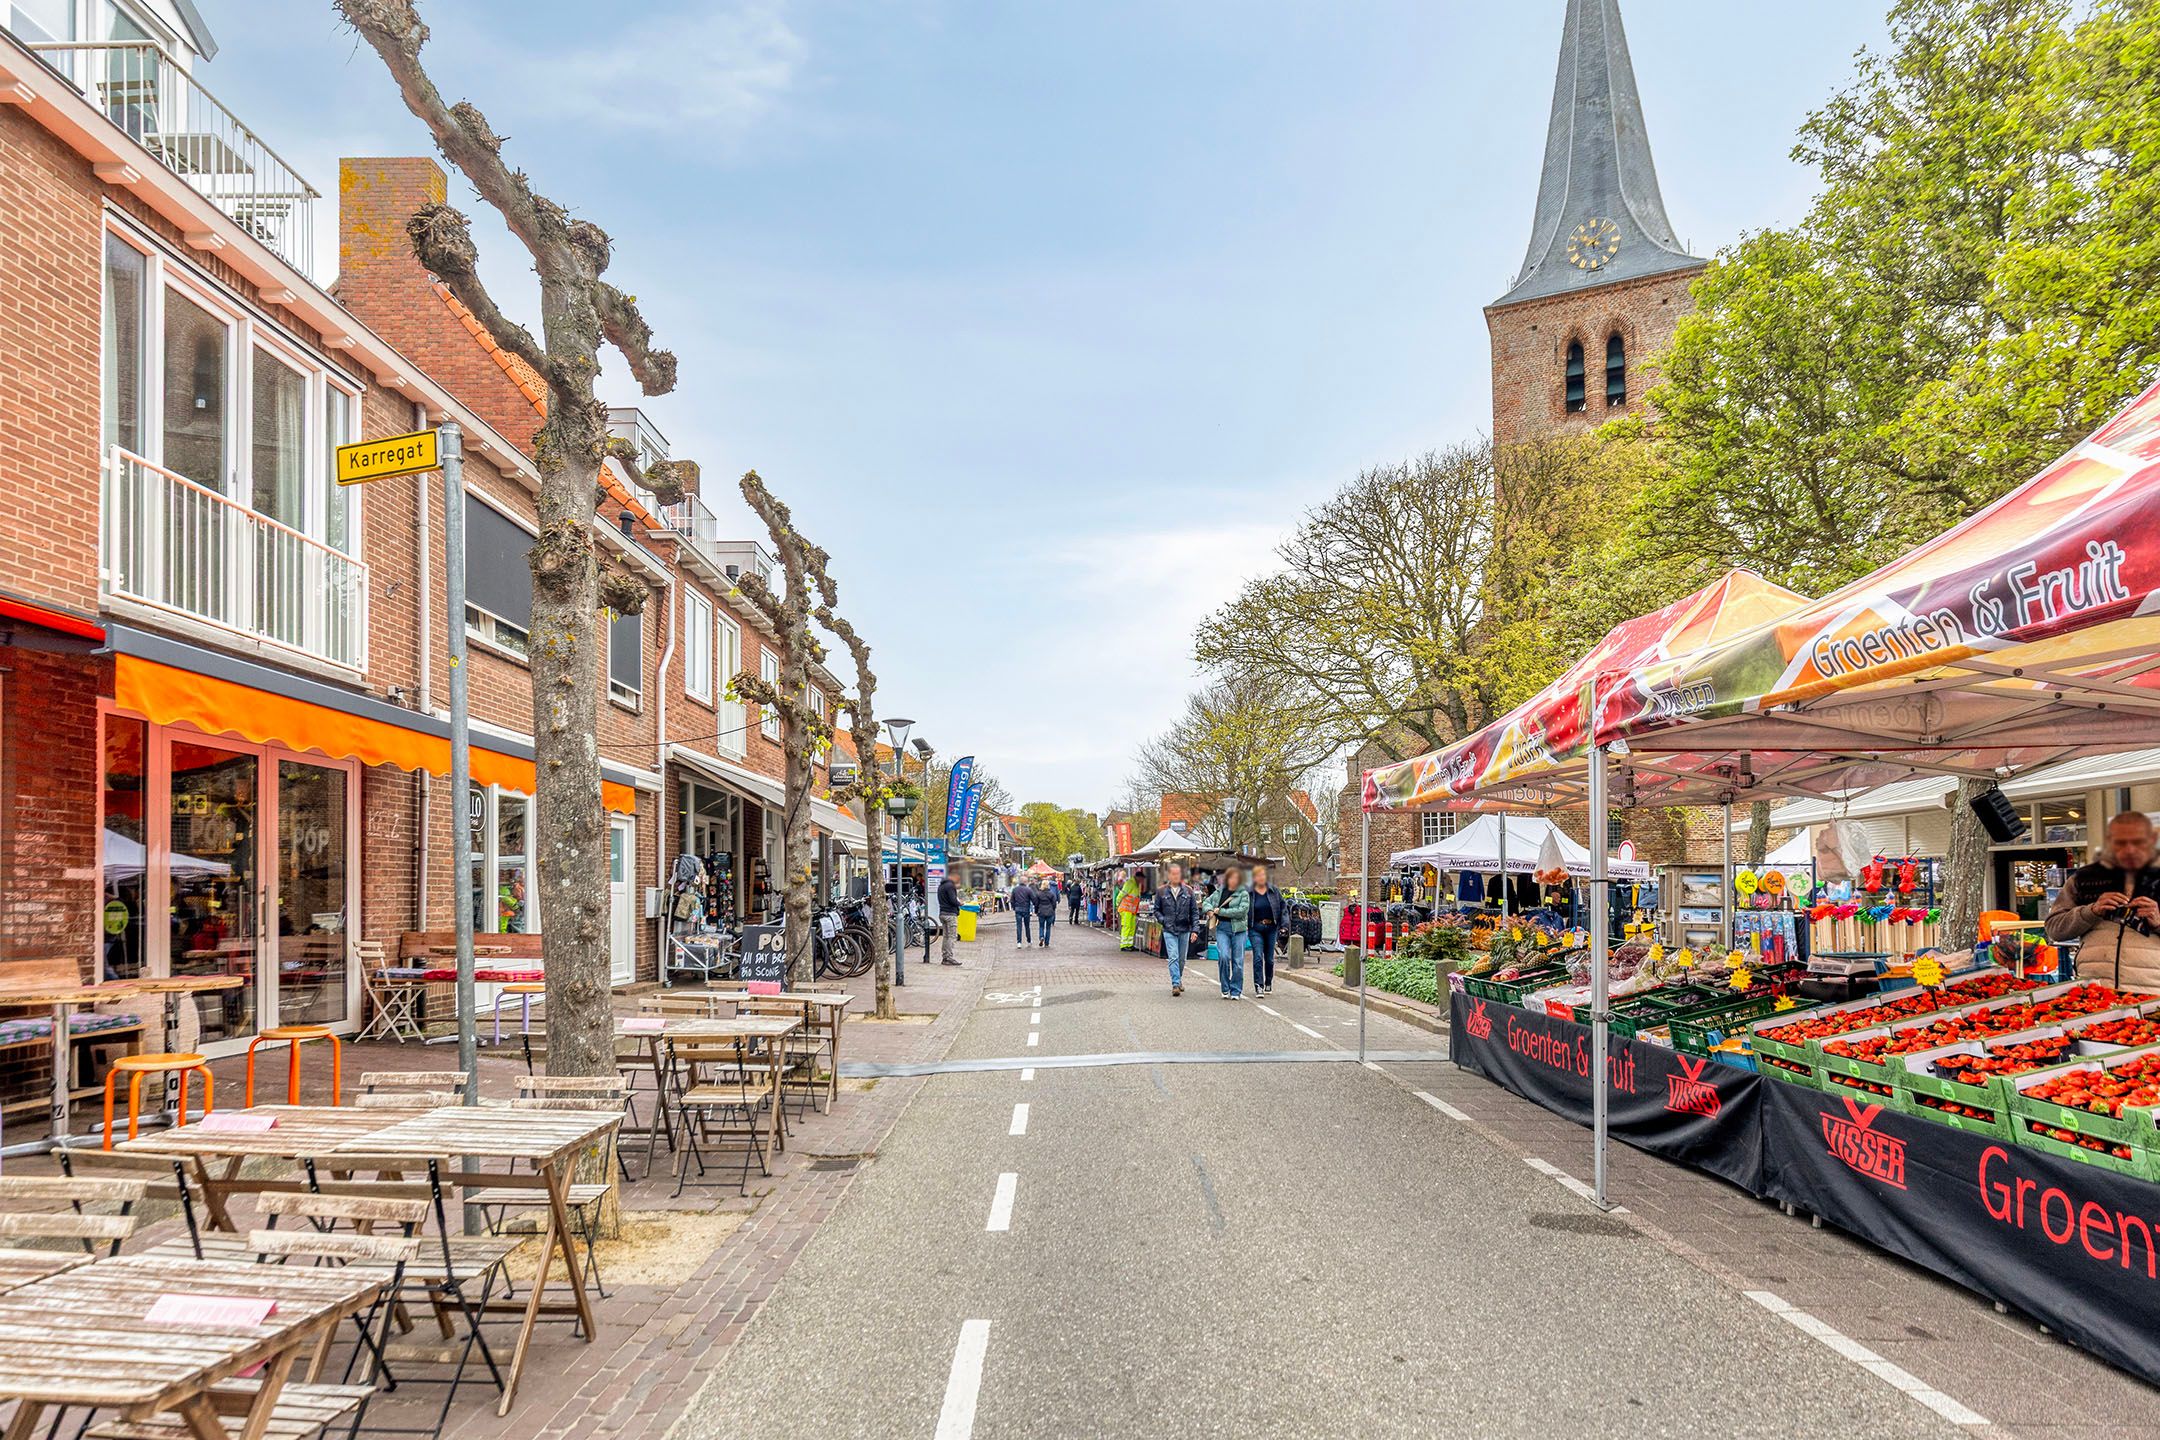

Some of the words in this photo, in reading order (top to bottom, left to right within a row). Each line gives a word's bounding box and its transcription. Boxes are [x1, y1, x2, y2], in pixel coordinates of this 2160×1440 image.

[349, 441, 423, 469] Karregat
[1811, 607, 1965, 677] Groenten
[1969, 576, 2009, 639] &
[2008, 540, 2130, 628] Fruit
[1649, 682, 1716, 722] VISSER
[948, 773, 960, 816] Nieuwe
[952, 771, 969, 818] Haring
[965, 794, 980, 832] Haring
[1449, 859, 1467, 867] Niet
[1469, 860, 1481, 868] de
[1483, 860, 1521, 869] Groste
[758, 929, 787, 951] PO
[1507, 1014, 1571, 1071] Groenten
[1576, 1035, 1589, 1077] &
[1605, 1048, 1636, 1094] ruit
[1668, 1077, 1722, 1116] VISSER
[1822, 1117, 1907, 1184] VISSER
[1978, 1145, 2160, 1279] Groen
